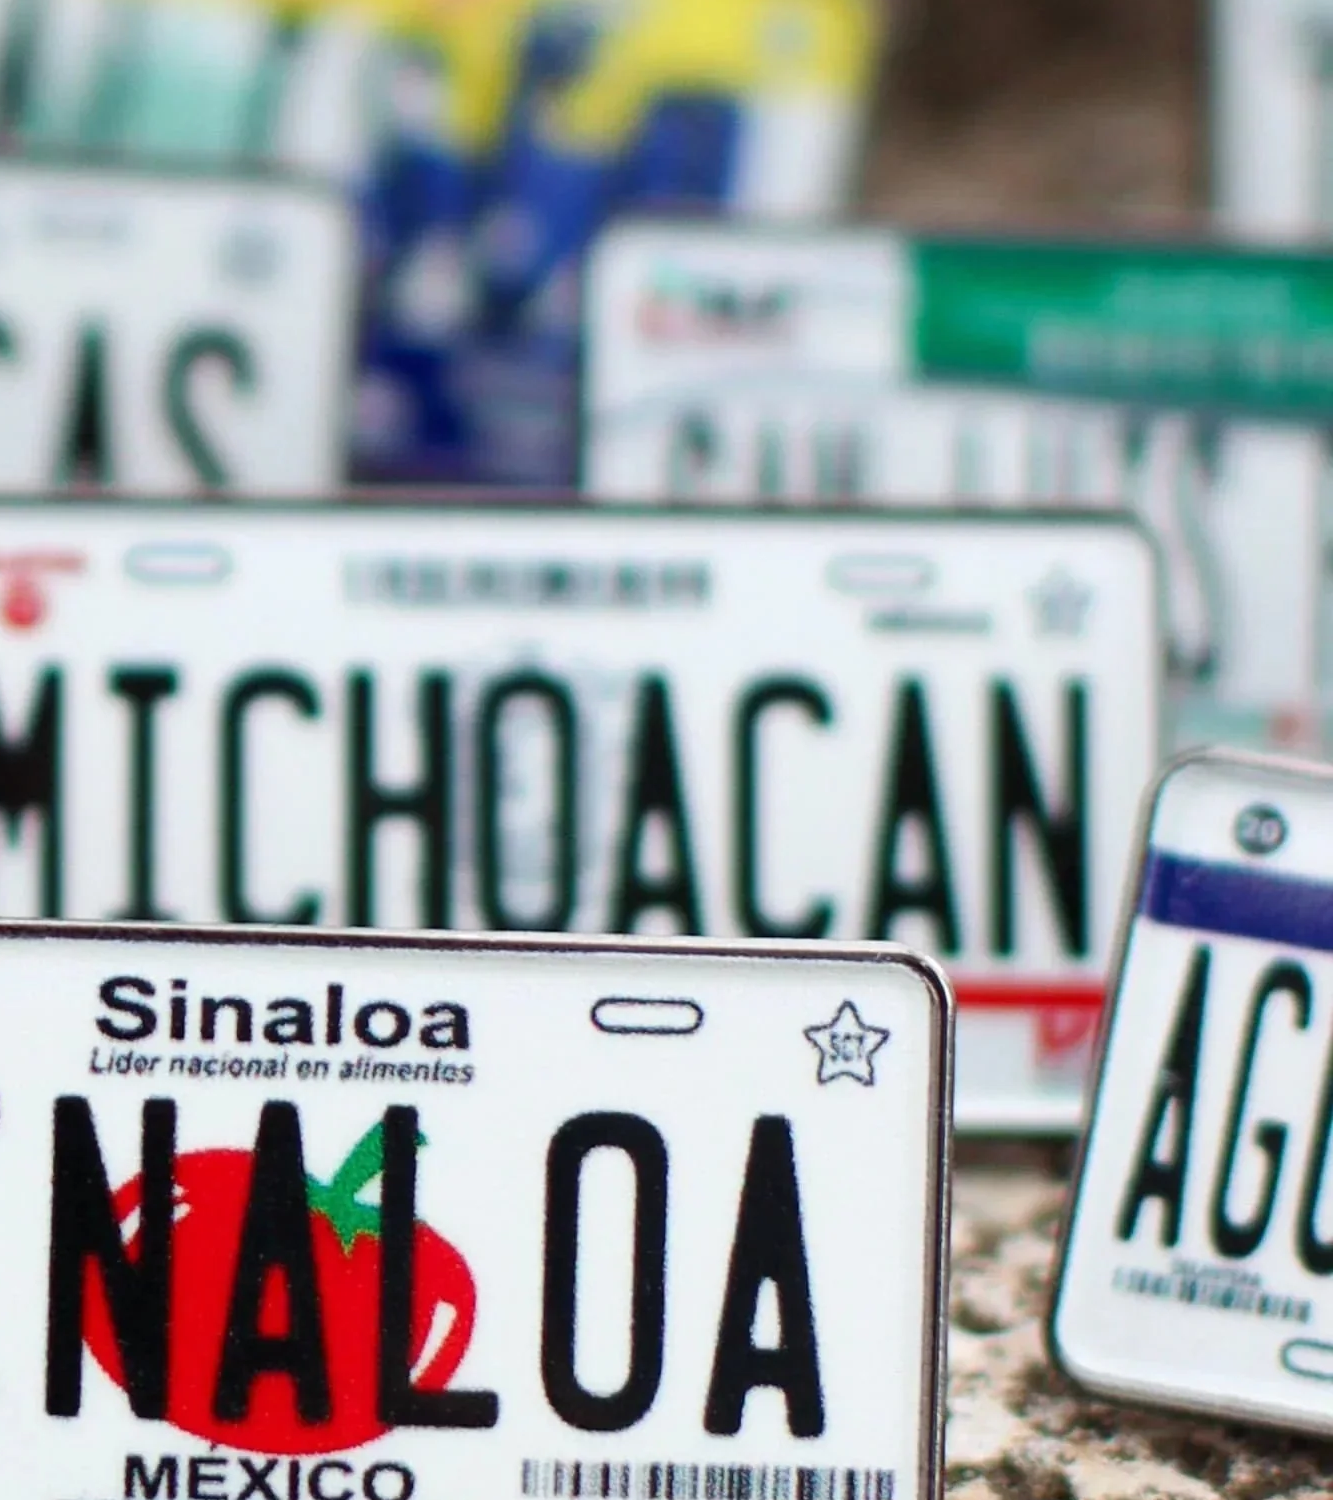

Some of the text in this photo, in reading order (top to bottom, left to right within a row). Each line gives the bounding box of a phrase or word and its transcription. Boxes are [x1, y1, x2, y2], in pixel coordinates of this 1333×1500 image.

[95, 975, 470, 1050] Sinaloa
[169, 1050, 288, 1080] nacional
[296, 1058, 330, 1078] en
[338, 1053, 476, 1084] alimentos
